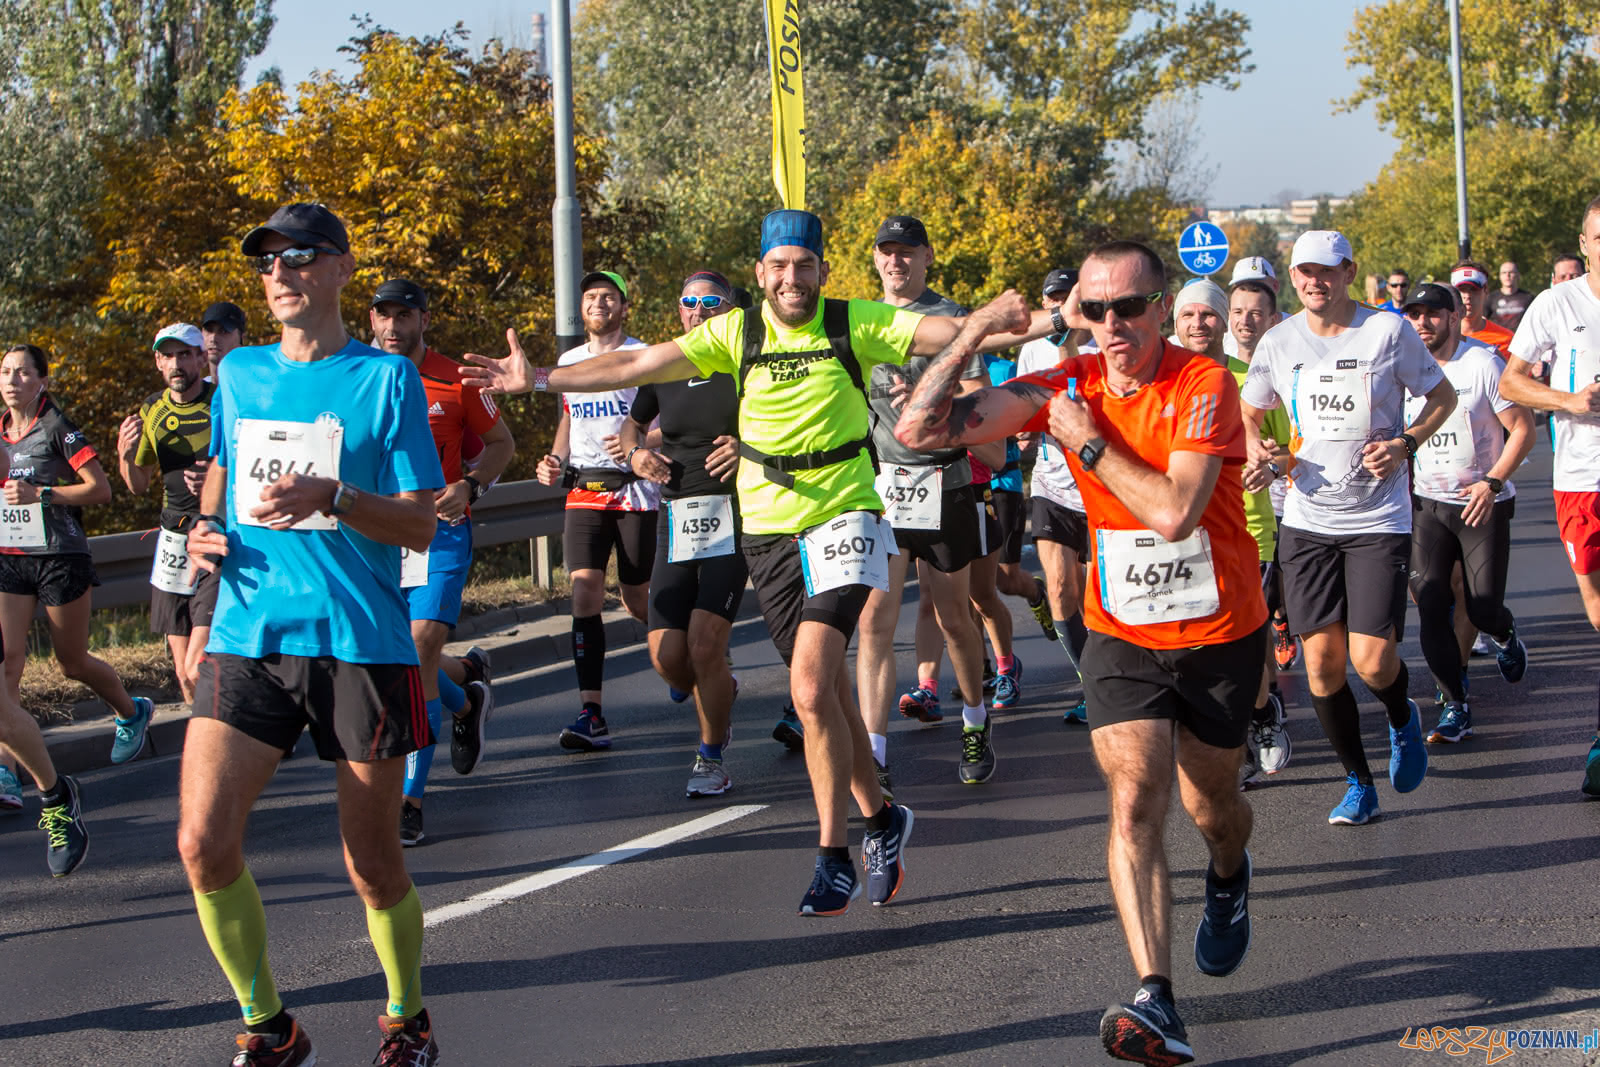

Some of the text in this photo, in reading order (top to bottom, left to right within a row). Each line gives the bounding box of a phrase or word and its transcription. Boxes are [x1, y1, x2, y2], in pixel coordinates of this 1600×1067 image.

[771, 367, 810, 382] TEAM
[571, 400, 629, 418] MAHLE
[1309, 394, 1356, 412] 1946
[1427, 432, 1458, 449] 1071
[885, 486, 930, 503] 4379
[2, 508, 32, 523] 5618
[681, 517, 721, 535] 4359
[823, 535, 876, 561] 5607
[161, 549, 188, 570] 3922
[1125, 559, 1193, 587] 4674
[1147, 588, 1174, 598] Tomek
